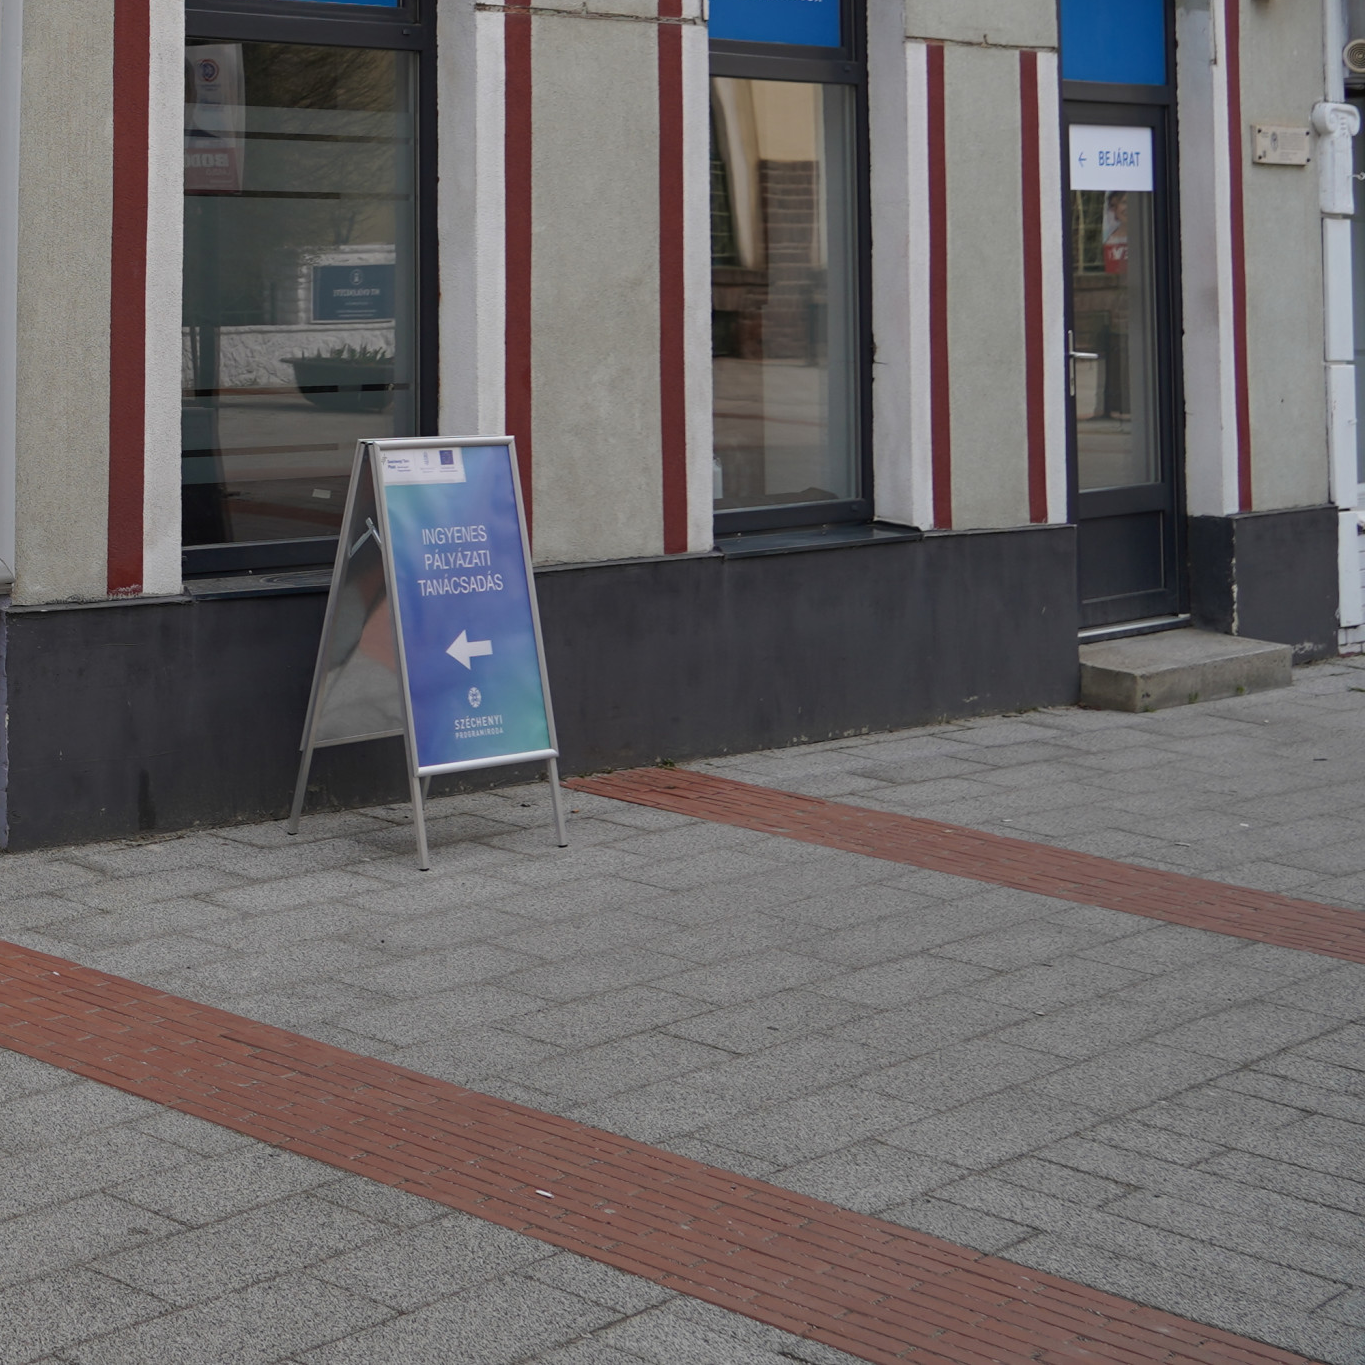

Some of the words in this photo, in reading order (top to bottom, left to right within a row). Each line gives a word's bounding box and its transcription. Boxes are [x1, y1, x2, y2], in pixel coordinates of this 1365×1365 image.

[1098, 148, 1140, 166] BEJÁRAT
[422, 525, 487, 545] INGYENES
[424, 547, 490, 570] PÁLYÁZATI
[417, 573, 503, 597] TANÁCSADÁS
[454, 714, 503, 730] SZÉCHENYI
[455, 727, 503, 739] PROGRAMIRODA
